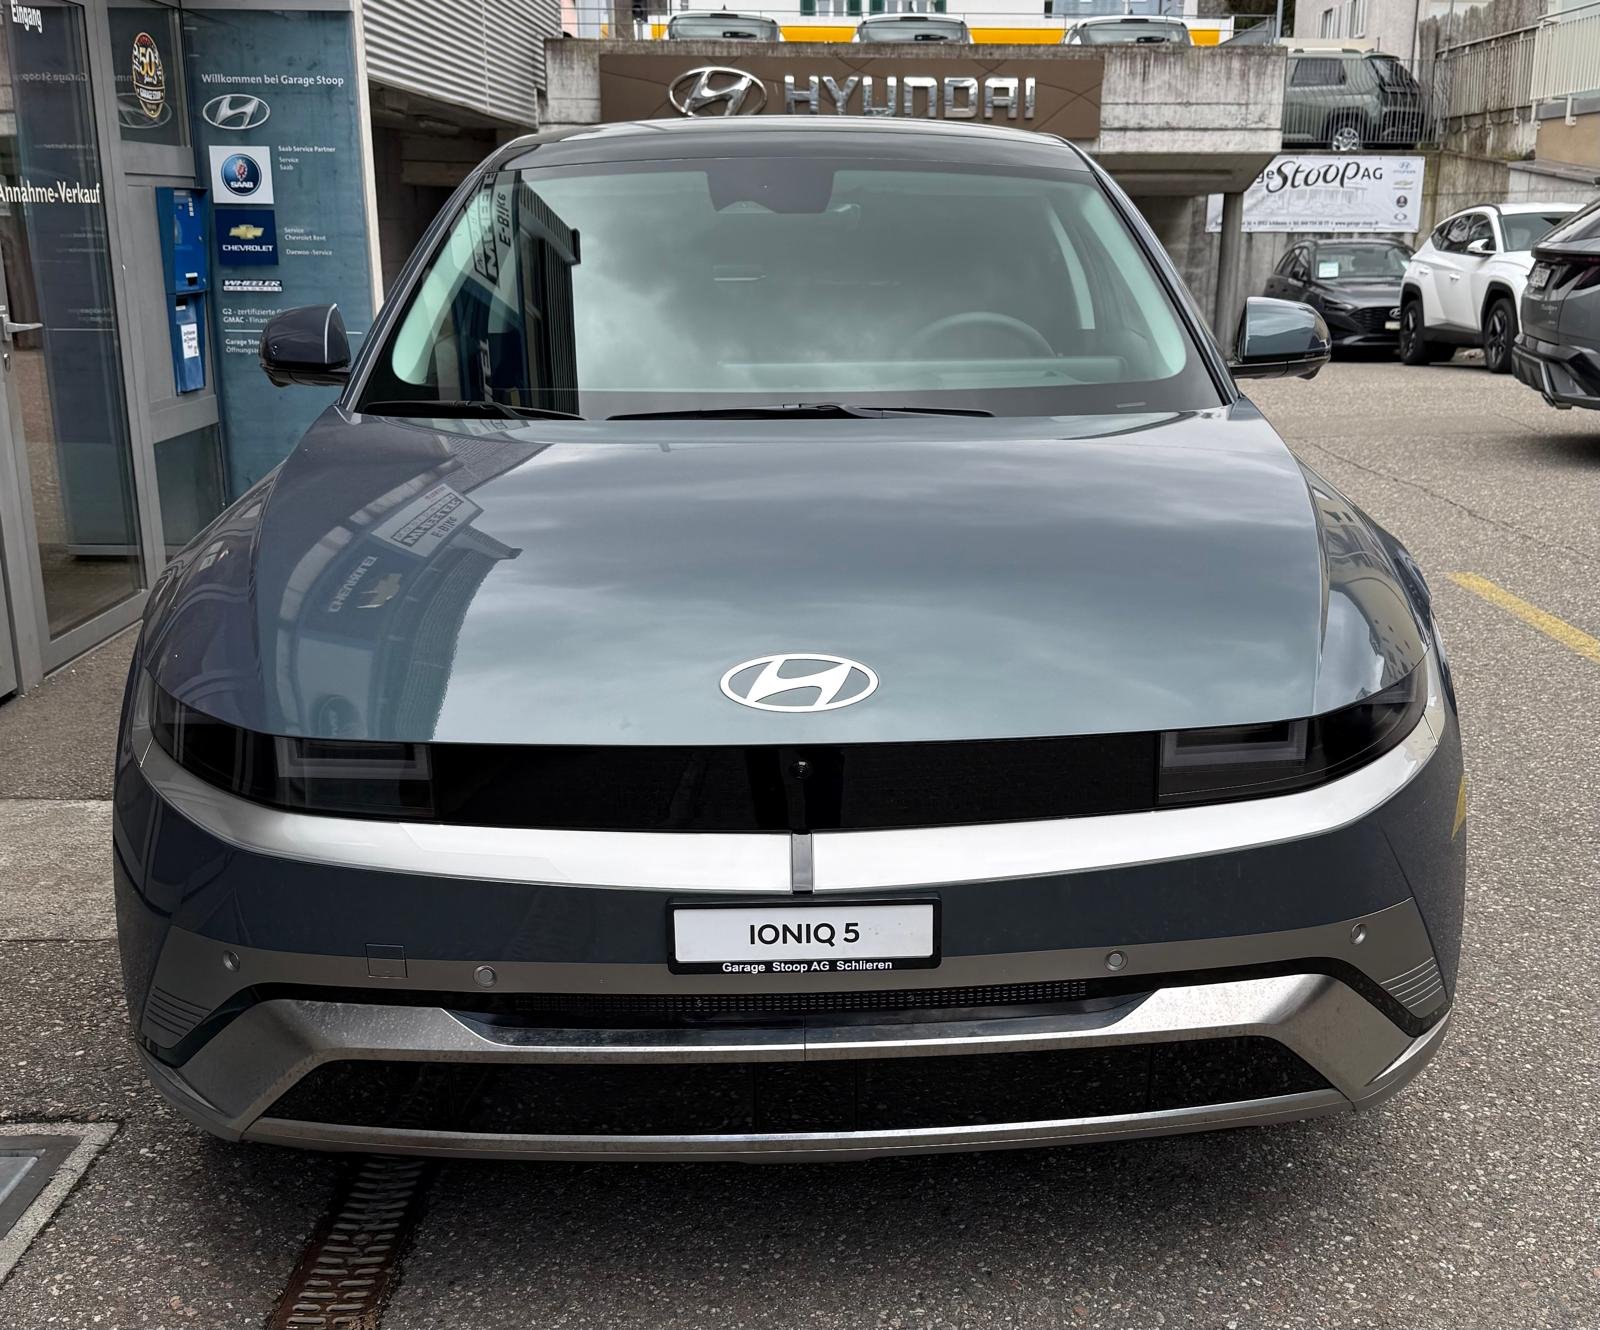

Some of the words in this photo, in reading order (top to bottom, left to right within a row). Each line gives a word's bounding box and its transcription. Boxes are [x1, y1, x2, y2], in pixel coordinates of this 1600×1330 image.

[11, 0, 43, 33] Eingang
[139, 46, 156, 76] 50
[201, 74, 262, 85] Willkommen
[264, 74, 279, 85] bei
[280, 75, 315, 88] Garage
[316, 75, 345, 88] Stoop
[784, 75, 1035, 119] HYUNDAI
[278, 145, 293, 153] Saab
[1266, 160, 1361, 194] Stoop
[1360, 167, 1383, 181] AG
[0, 180, 100, 204] Annahme-Verkauf
[230, 181, 254, 189] SAAB
[222, 244, 274, 252] CHEVROLET
[223, 316, 245, 324] GMAC
[225, 338, 247, 347] Garage
[749, 922, 836, 947] IONIQ
[843, 922, 860, 943] 5
[722, 962, 765, 974] Garage
[772, 962, 808, 973] Stoop
[810, 961, 830, 972] AG
[836, 960, 893, 971] Schlieren
